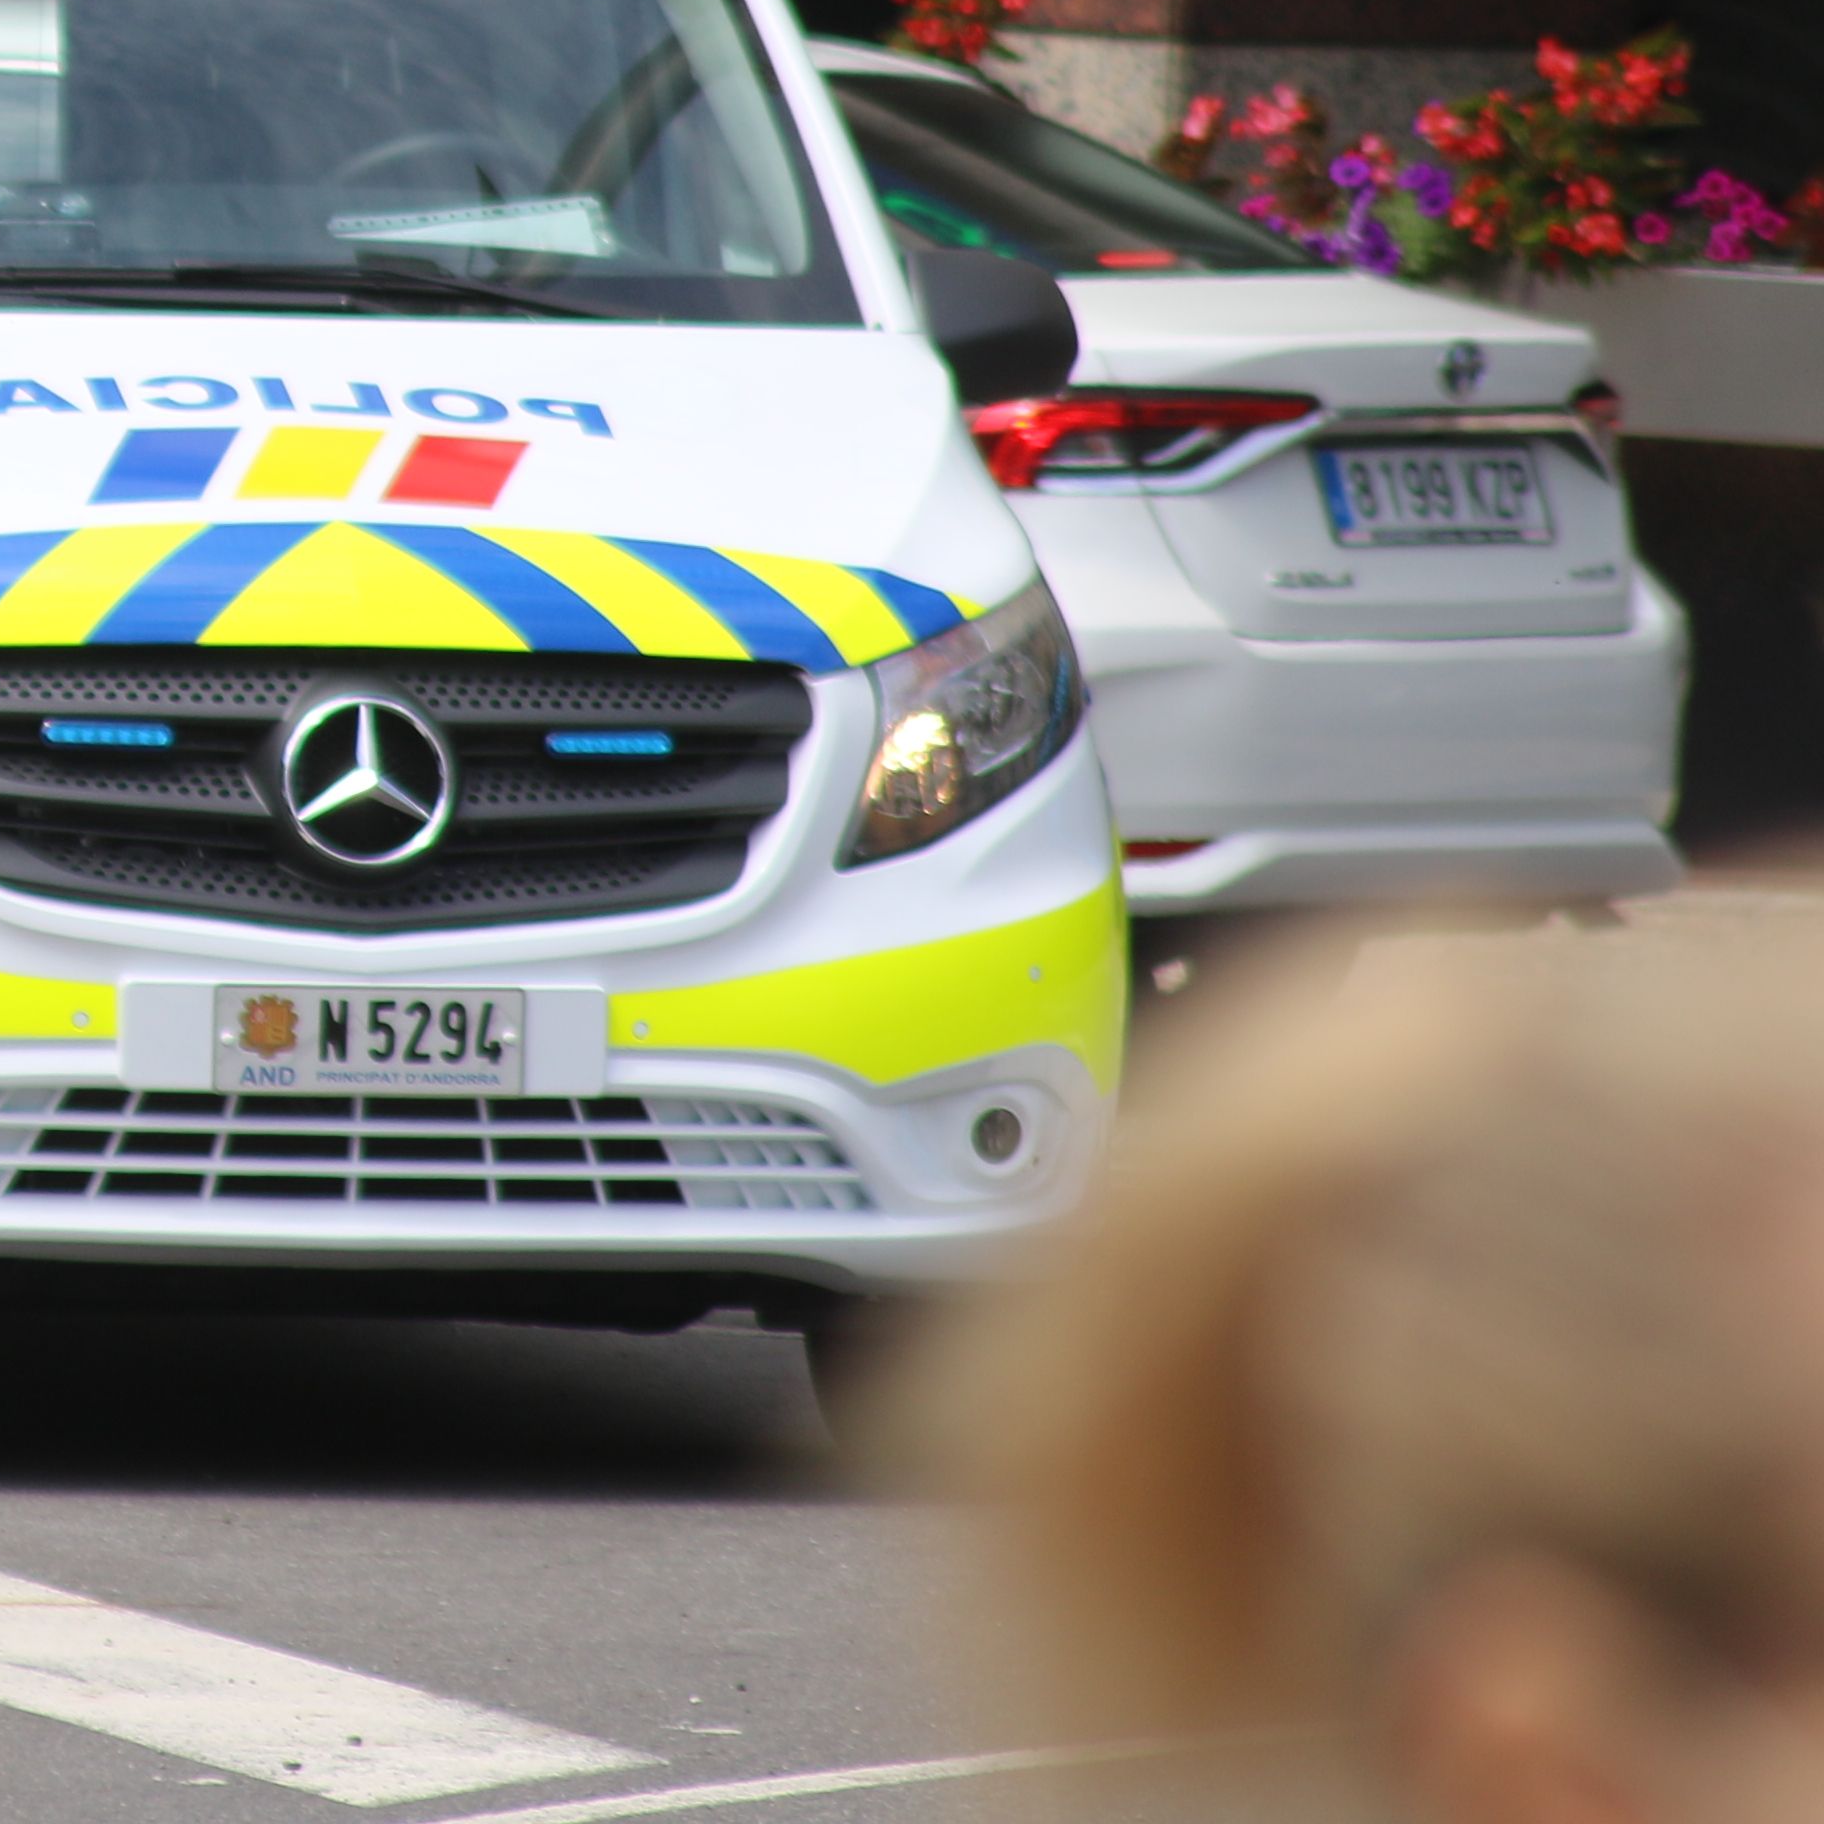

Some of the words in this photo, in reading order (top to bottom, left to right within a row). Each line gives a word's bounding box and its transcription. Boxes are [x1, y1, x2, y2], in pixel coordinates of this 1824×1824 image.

[318, 998, 349, 1063] N
[367, 998, 503, 1065] 5294
[239, 1065, 296, 1086] AND
[316, 1070, 399, 1085] PRINCIPAT
